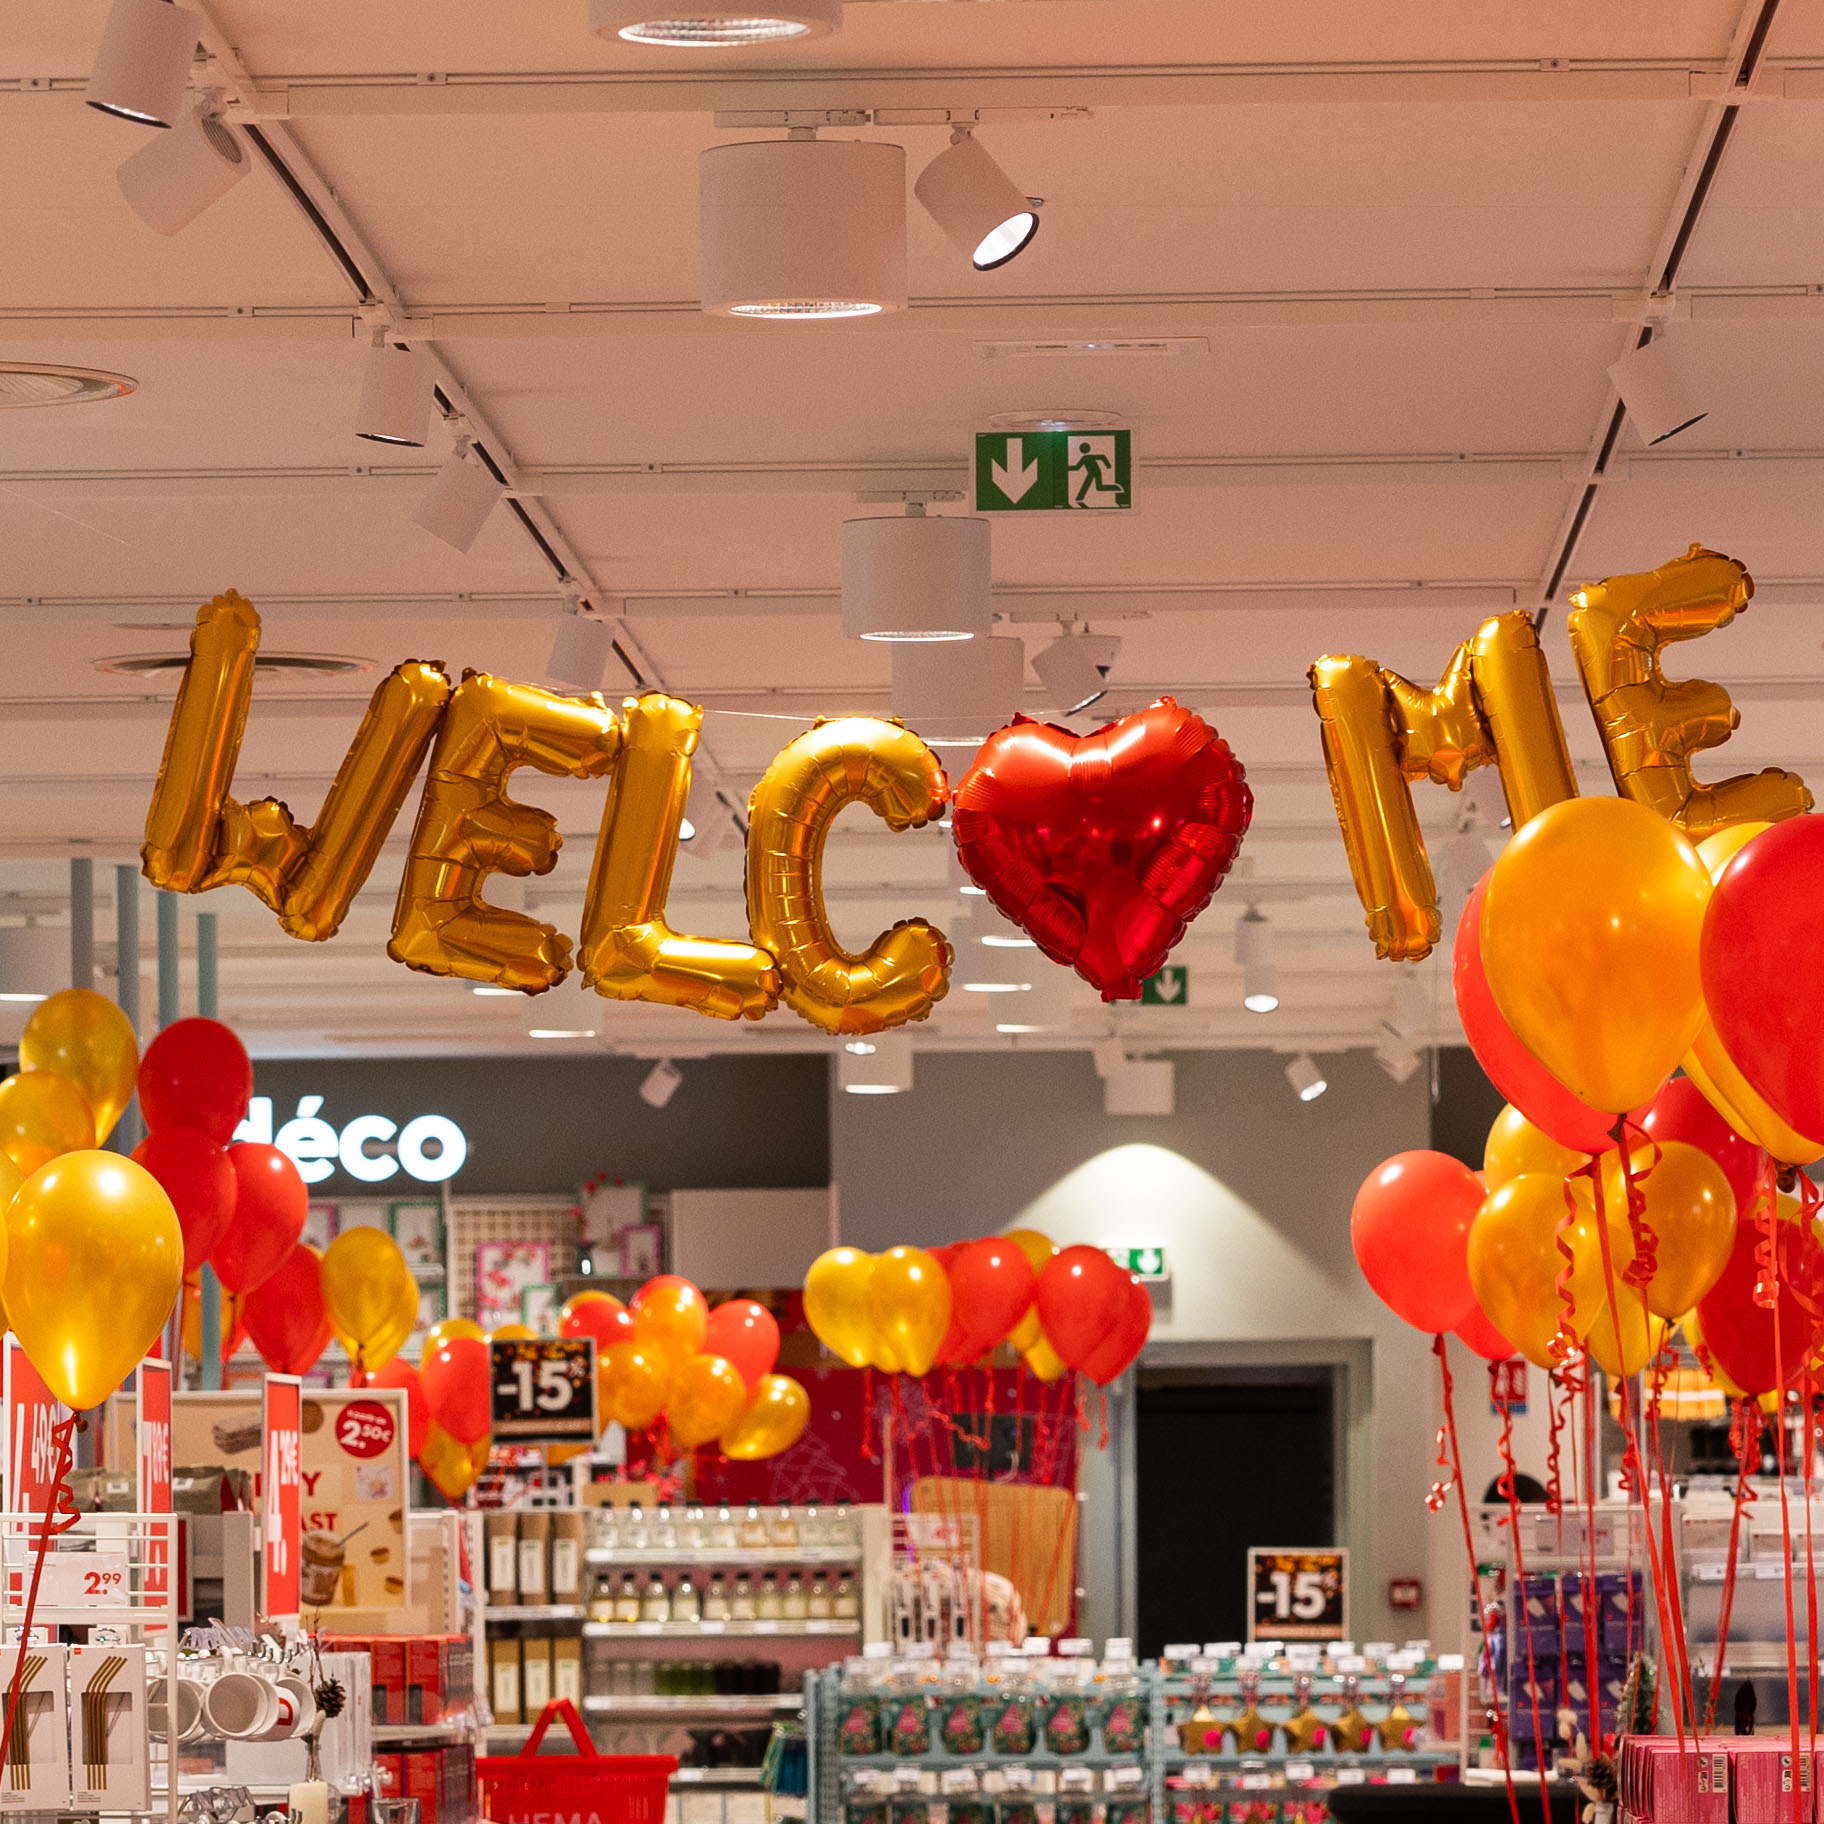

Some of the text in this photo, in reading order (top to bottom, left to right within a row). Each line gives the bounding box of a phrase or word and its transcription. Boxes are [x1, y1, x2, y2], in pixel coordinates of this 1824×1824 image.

[232, 1095, 467, 1183] déco
[339, 1420, 393, 1450] 2.50€
[83, 1571, 123, 1595] 2.99
